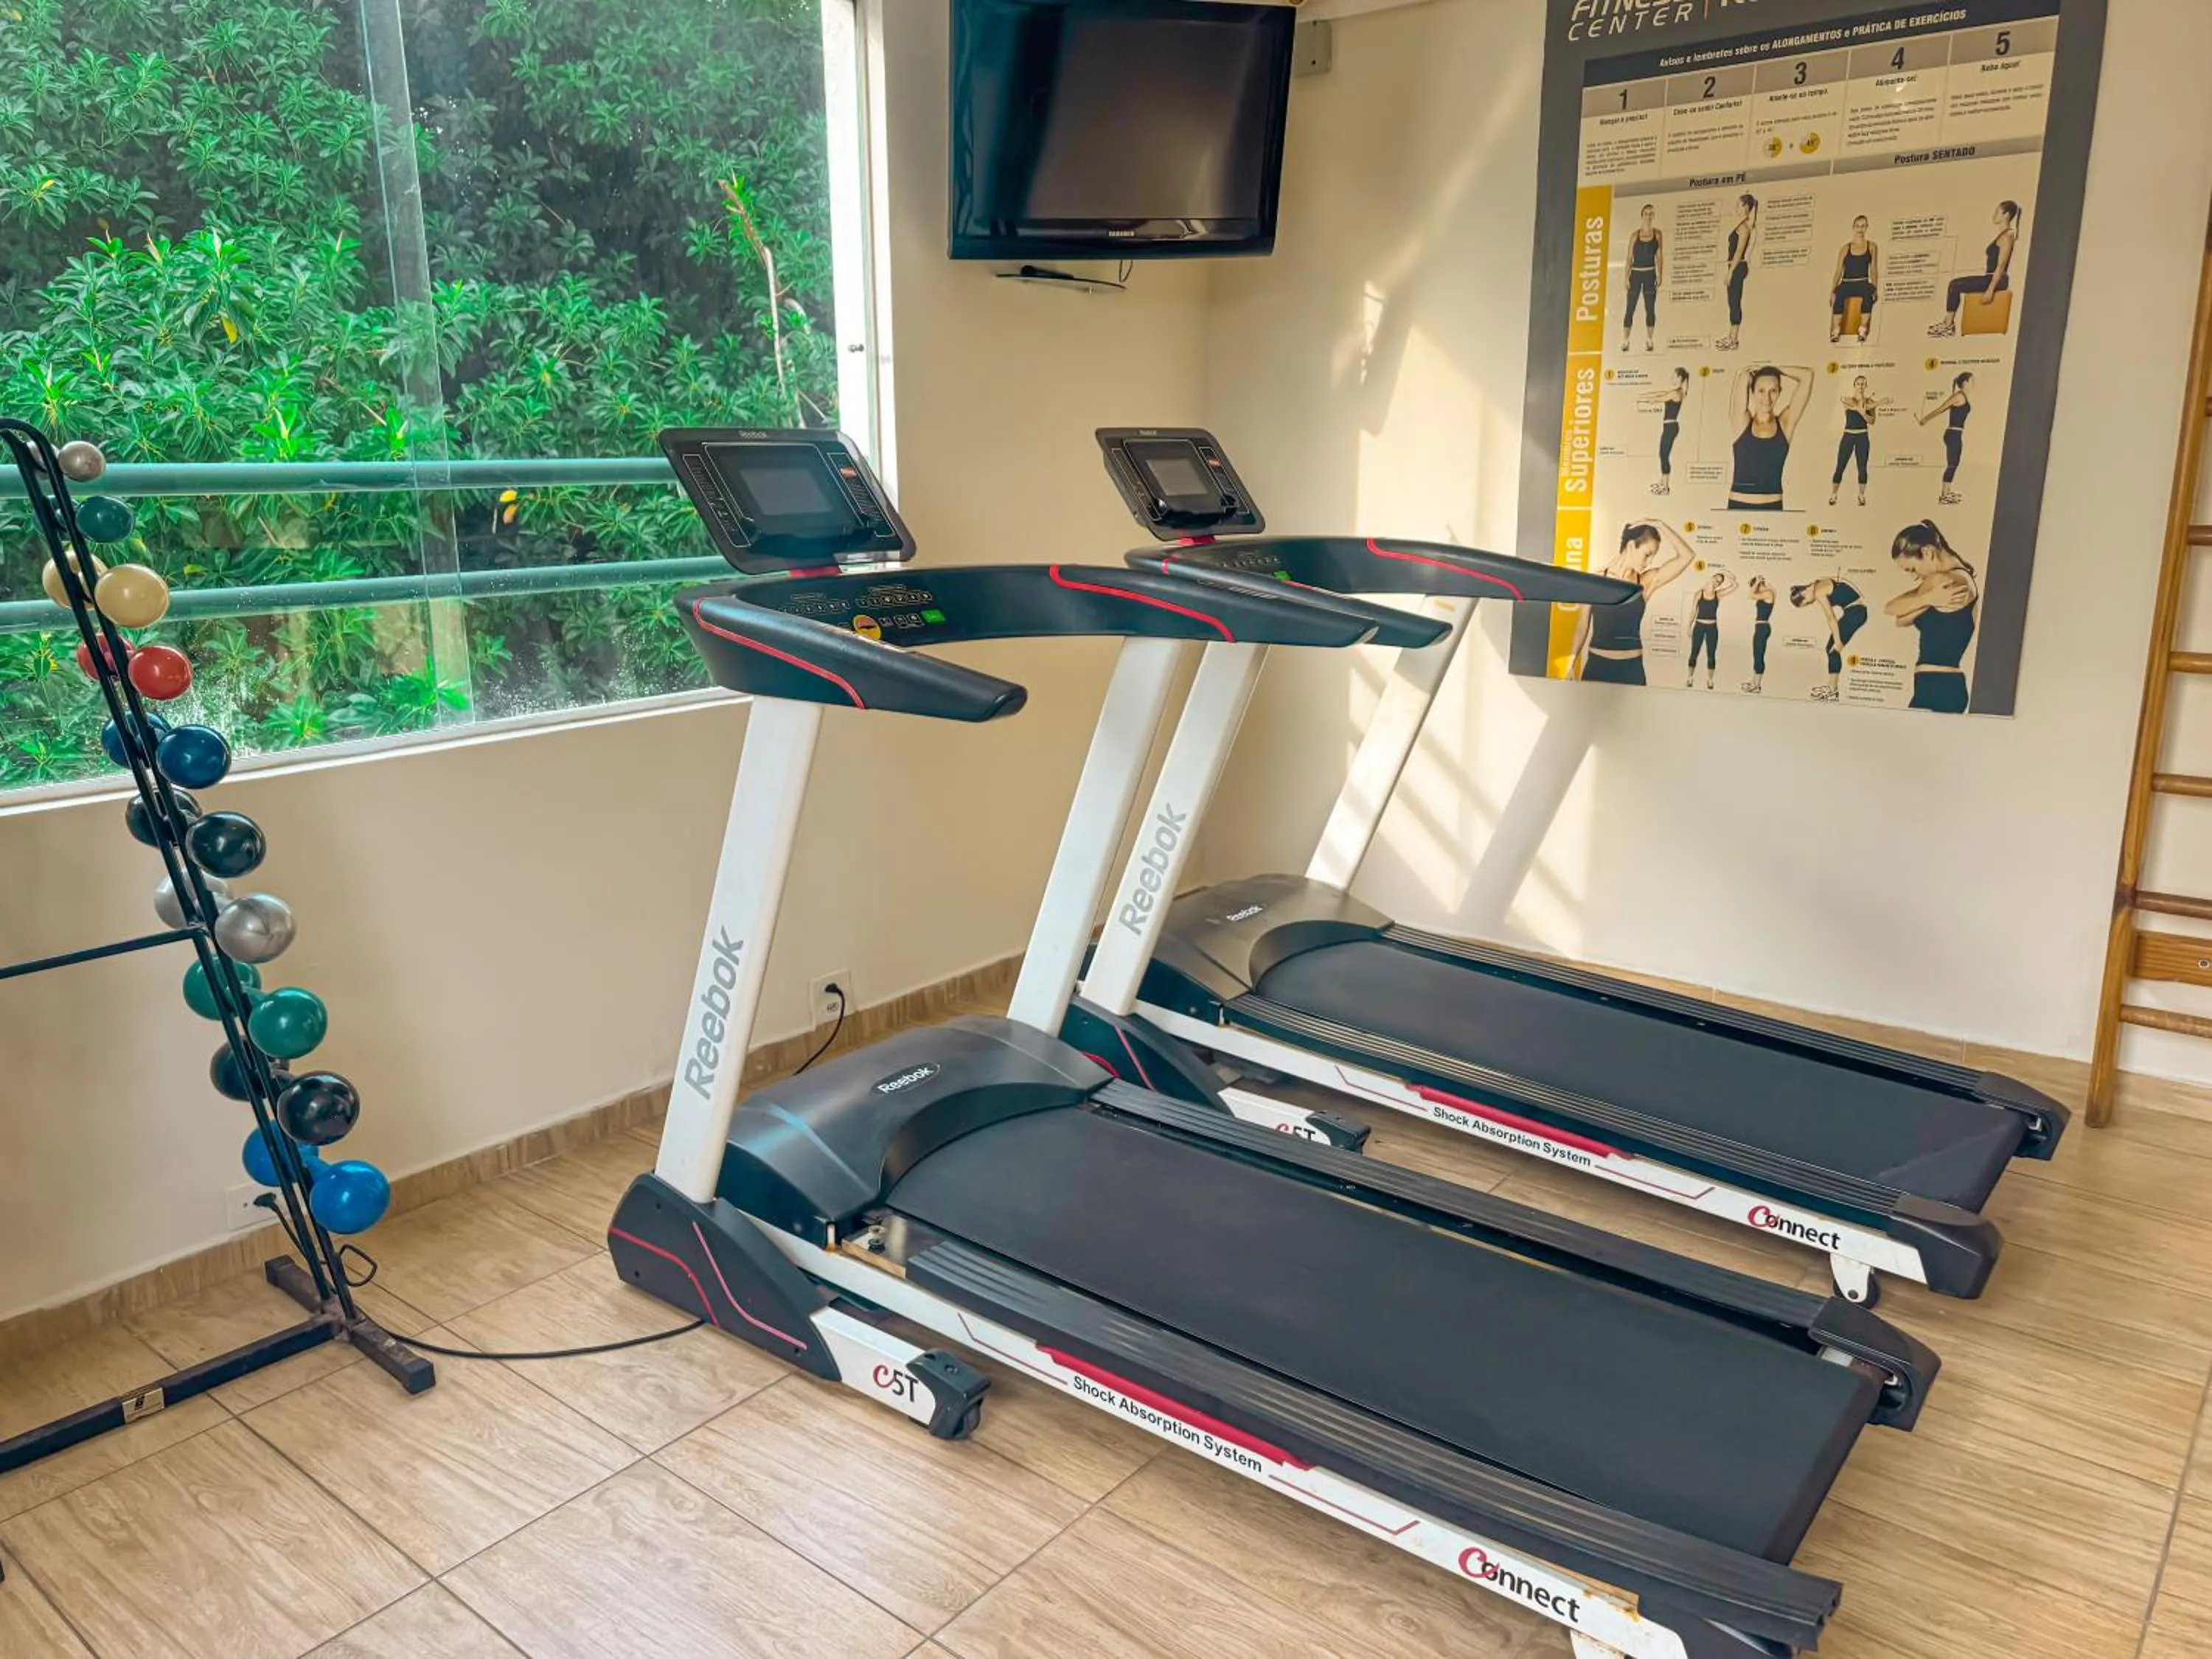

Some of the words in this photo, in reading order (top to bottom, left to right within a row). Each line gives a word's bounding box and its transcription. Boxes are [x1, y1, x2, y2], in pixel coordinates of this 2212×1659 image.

[1568, 3, 1693, 41] CENTER
[1735, 44, 1759, 55] sobre
[1760, 42, 1770, 51] os
[1772, 29, 1843, 50] ALONGAMENTOS
[1844, 29, 1850, 38] e
[1852, 21, 1891, 36] PRÁTICA
[1894, 18, 1907, 29] DE
[1909, 9, 1967, 27] EXERCÍCIOS
[1891, 46, 1905, 70] 4
[1995, 30, 2011, 55] 5
[1703, 76, 1716, 99] 2
[1794, 61, 1807, 85] 3
[1619, 88, 1627, 110] 1
[1894, 151, 1930, 164] Postura
[1932, 146, 1976, 161] SENTADO
[1689, 178, 1719, 188] Postura
[1576, 215, 1604, 321] Posturas
[1565, 367, 1595, 493] Superiores
[1119, 801, 1187, 936] Reebok
[684, 925, 744, 1100] Reebok
[877, 1067, 935, 1094] Reebok
[1433, 1107, 1470, 1127] Shock
[1472, 1119, 1541, 1150] Absorption
[1543, 1142, 1591, 1166] System
[1747, 1205, 1841, 1250] Connect
[873, 1365, 919, 1402] C5T
[1073, 1375, 1116, 1406] Shock
[1119, 1397, 1200, 1444] Absorption
[1203, 1435, 1262, 1473] System
[1458, 1546, 1580, 1623] Connect
